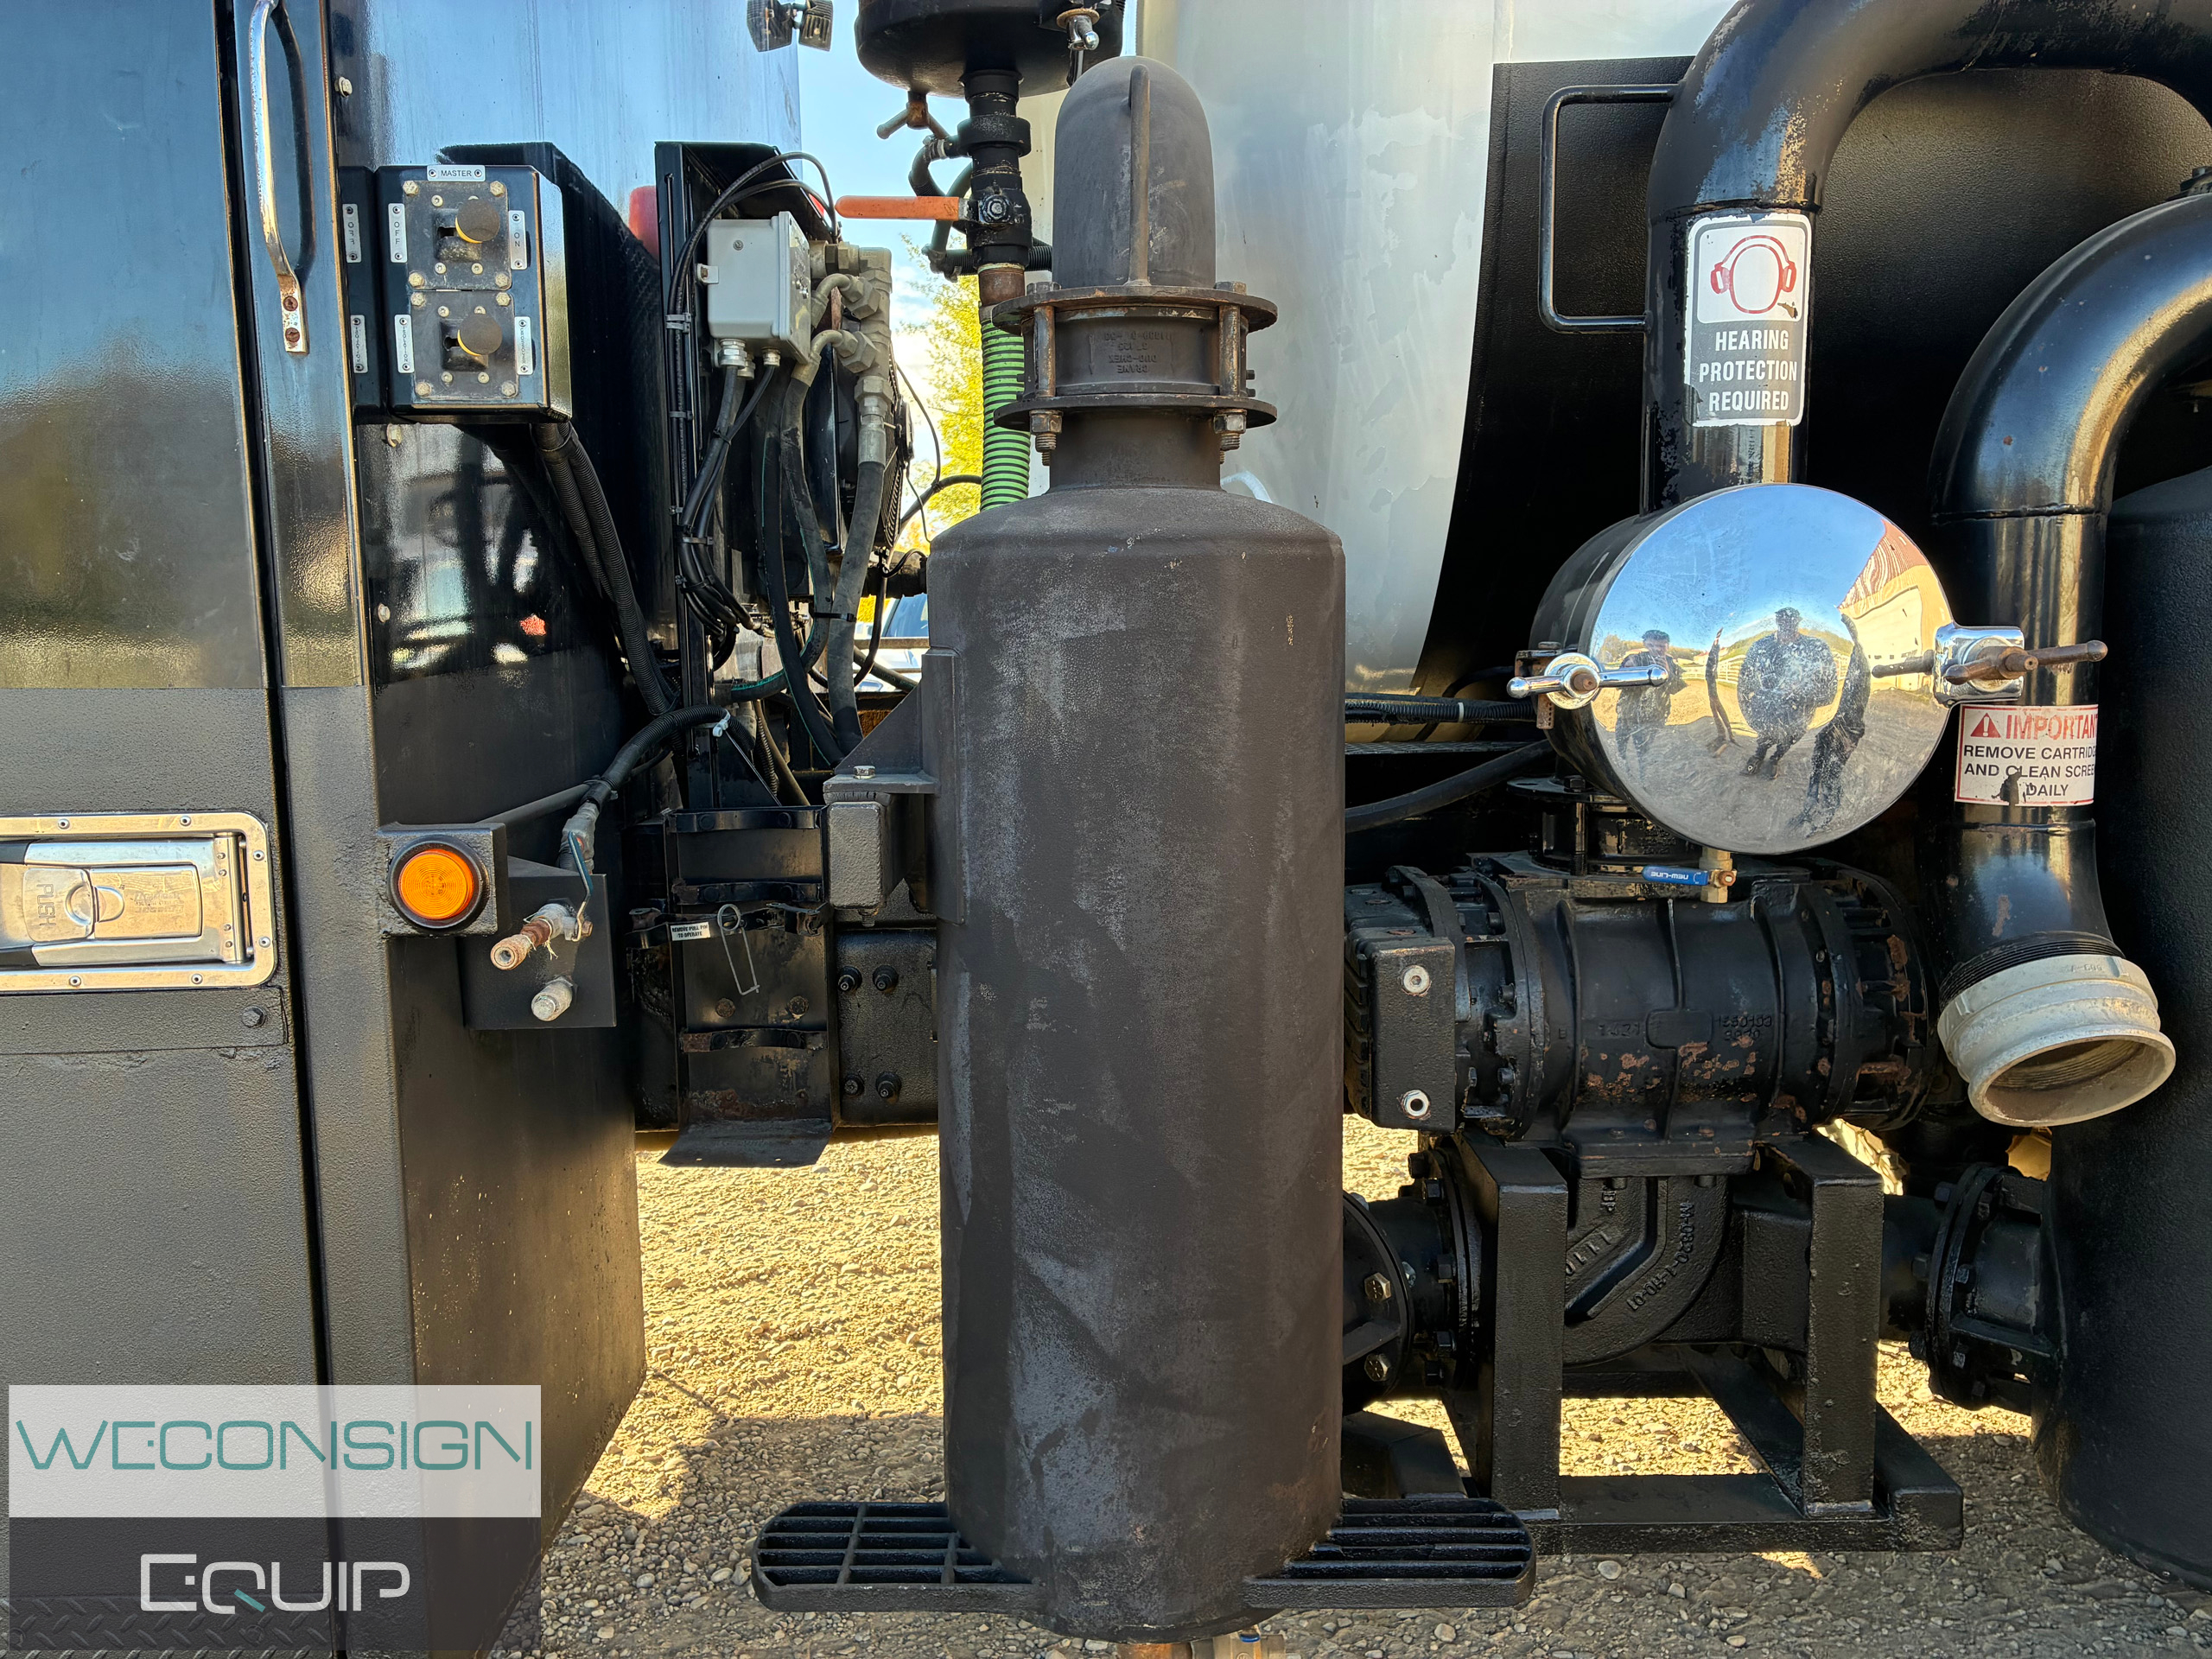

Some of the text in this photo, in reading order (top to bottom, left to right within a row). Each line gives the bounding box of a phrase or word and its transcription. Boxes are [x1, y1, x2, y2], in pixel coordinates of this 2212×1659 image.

[514, 232, 520, 247] ON
[1715, 329, 1789, 352] HEARING
[1699, 359, 1797, 383] PROTECTION
[1708, 391, 1789, 412] REQUIRED
[1963, 745, 2036, 760] REMOVE
[1964, 763, 2095, 778] AND CLEAN SCREE
[2025, 784, 2069, 796] DAILY
[35, 883, 56, 926] PUSH
